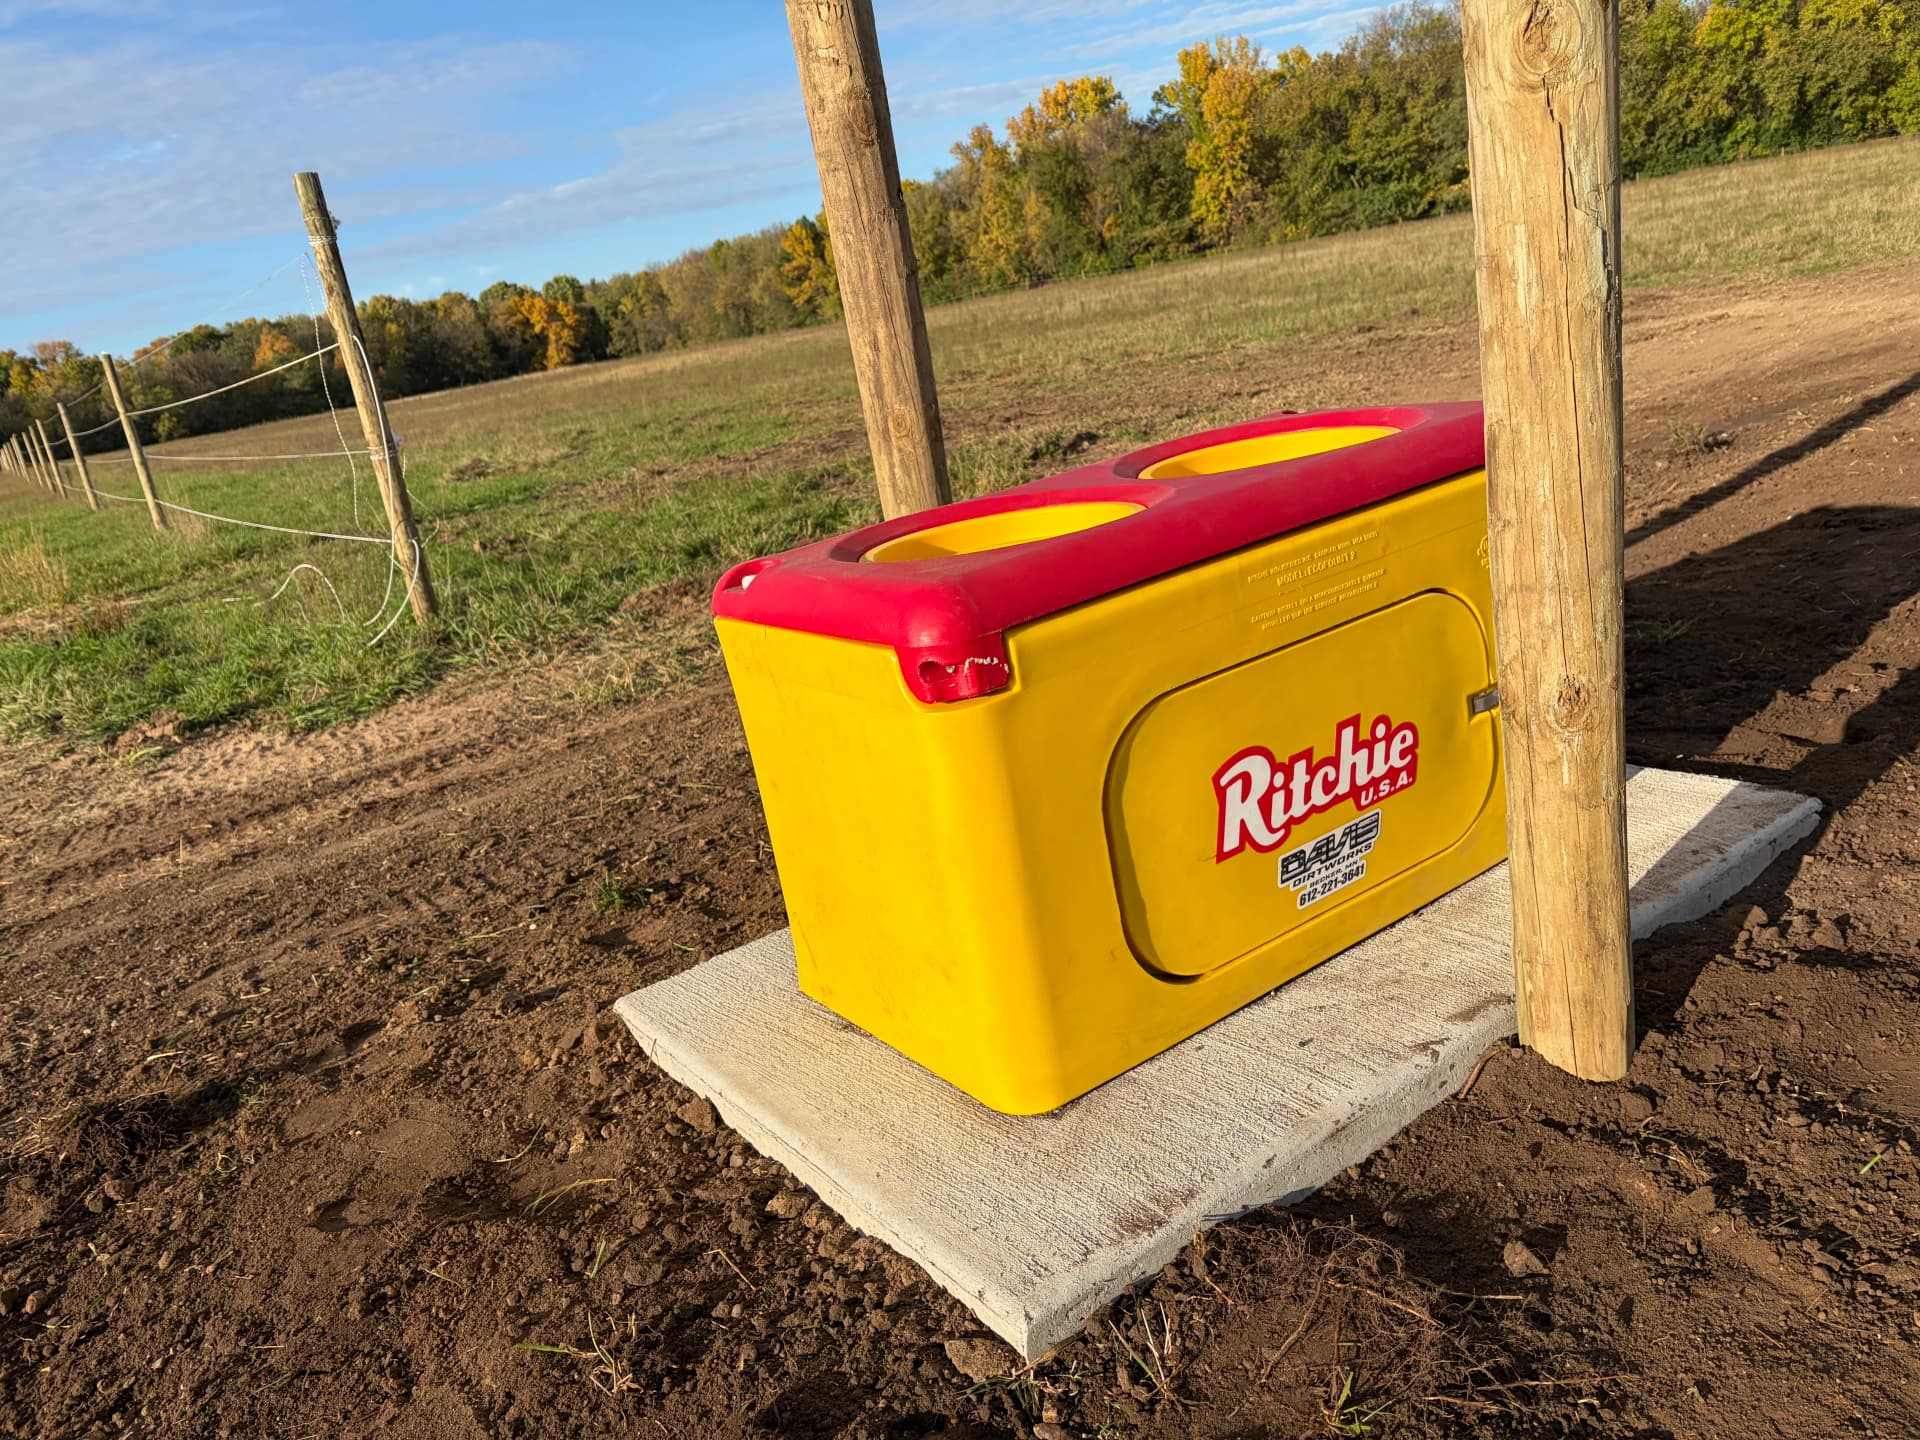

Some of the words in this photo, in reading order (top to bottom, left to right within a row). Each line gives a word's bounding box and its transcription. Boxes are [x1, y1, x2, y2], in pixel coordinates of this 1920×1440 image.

[1219, 722, 1415, 853] Ritchie
[1360, 770, 1414, 807] U.S.A.
[1281, 811, 1379, 885] DAVIS
[1292, 842, 1373, 888] DIRTWORKS
[1345, 860, 1358, 869] MN
[1299, 862, 1365, 907] 612-221-3641
